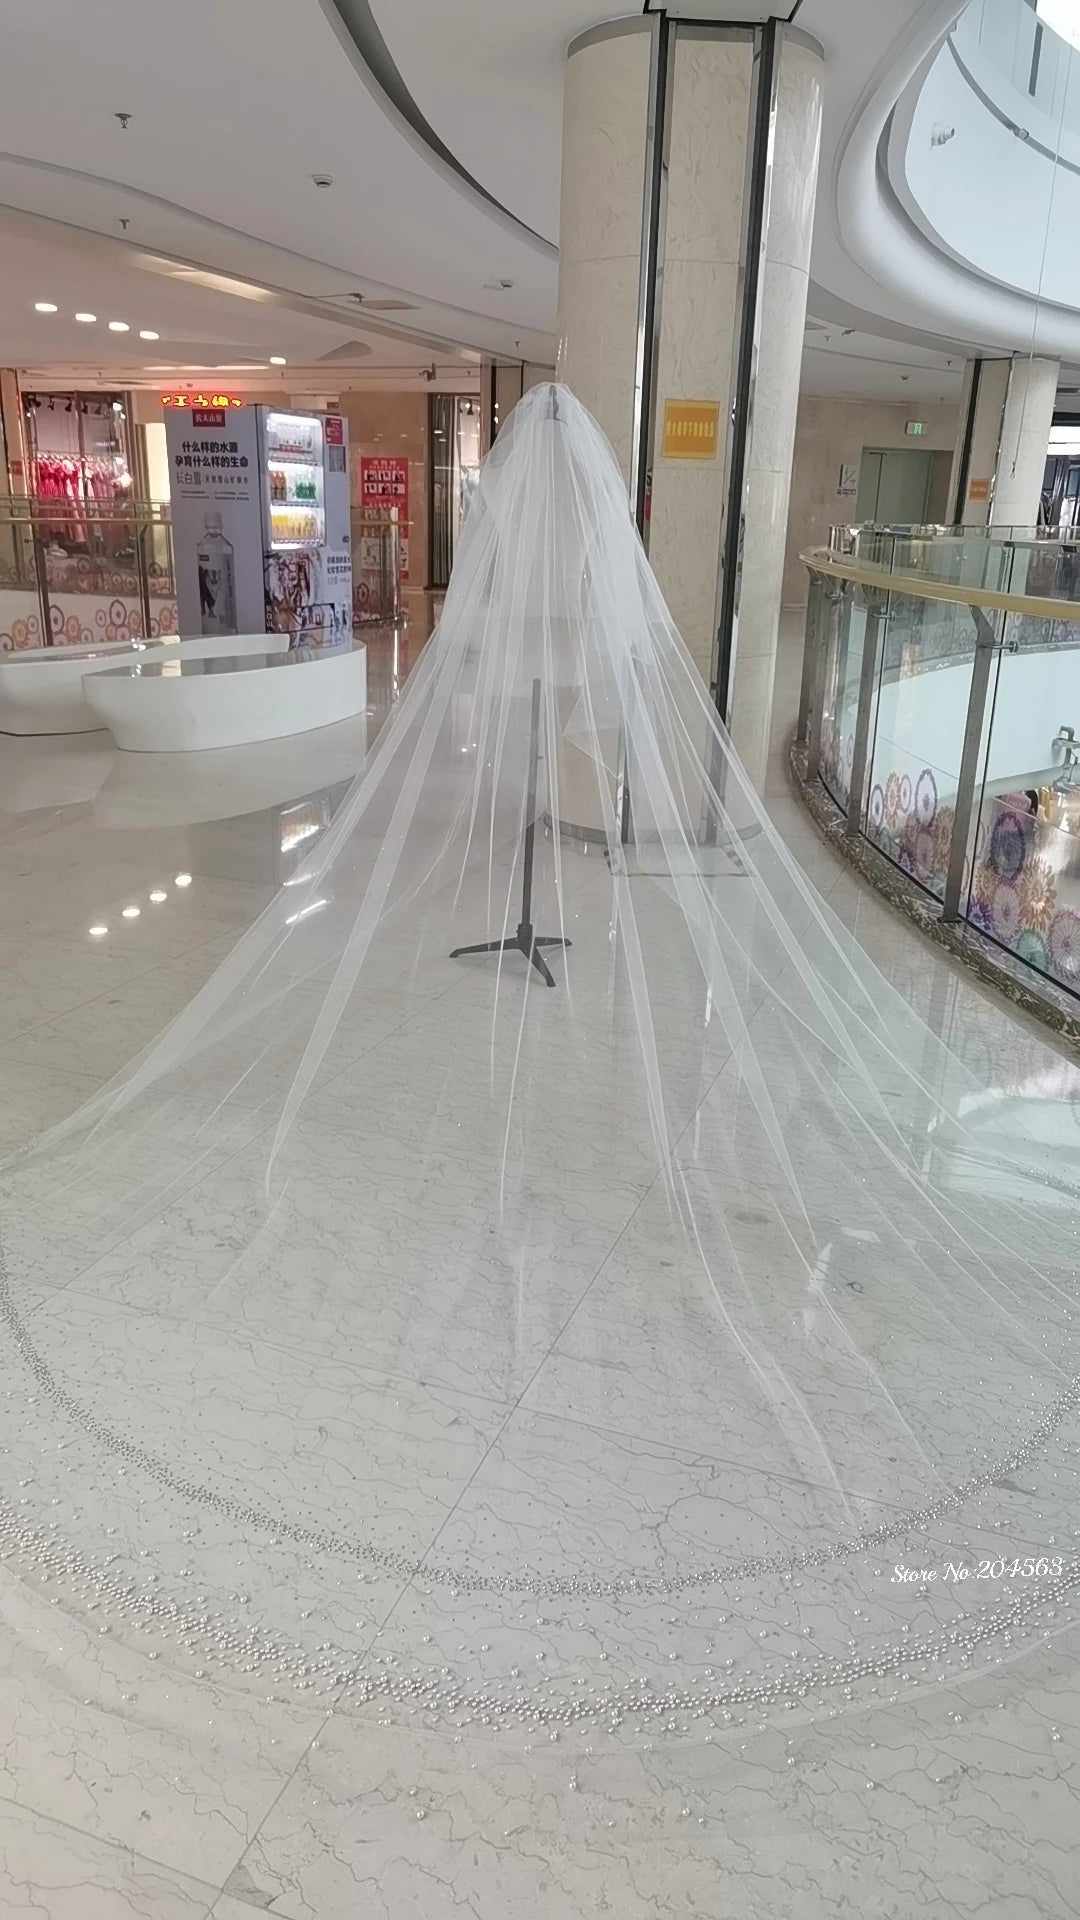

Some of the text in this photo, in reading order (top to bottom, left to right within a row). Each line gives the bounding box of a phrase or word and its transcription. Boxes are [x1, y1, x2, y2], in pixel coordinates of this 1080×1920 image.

[182, 441, 238, 454] 什么样的水源
[175, 455, 249, 468] 孕育什么样的生命
